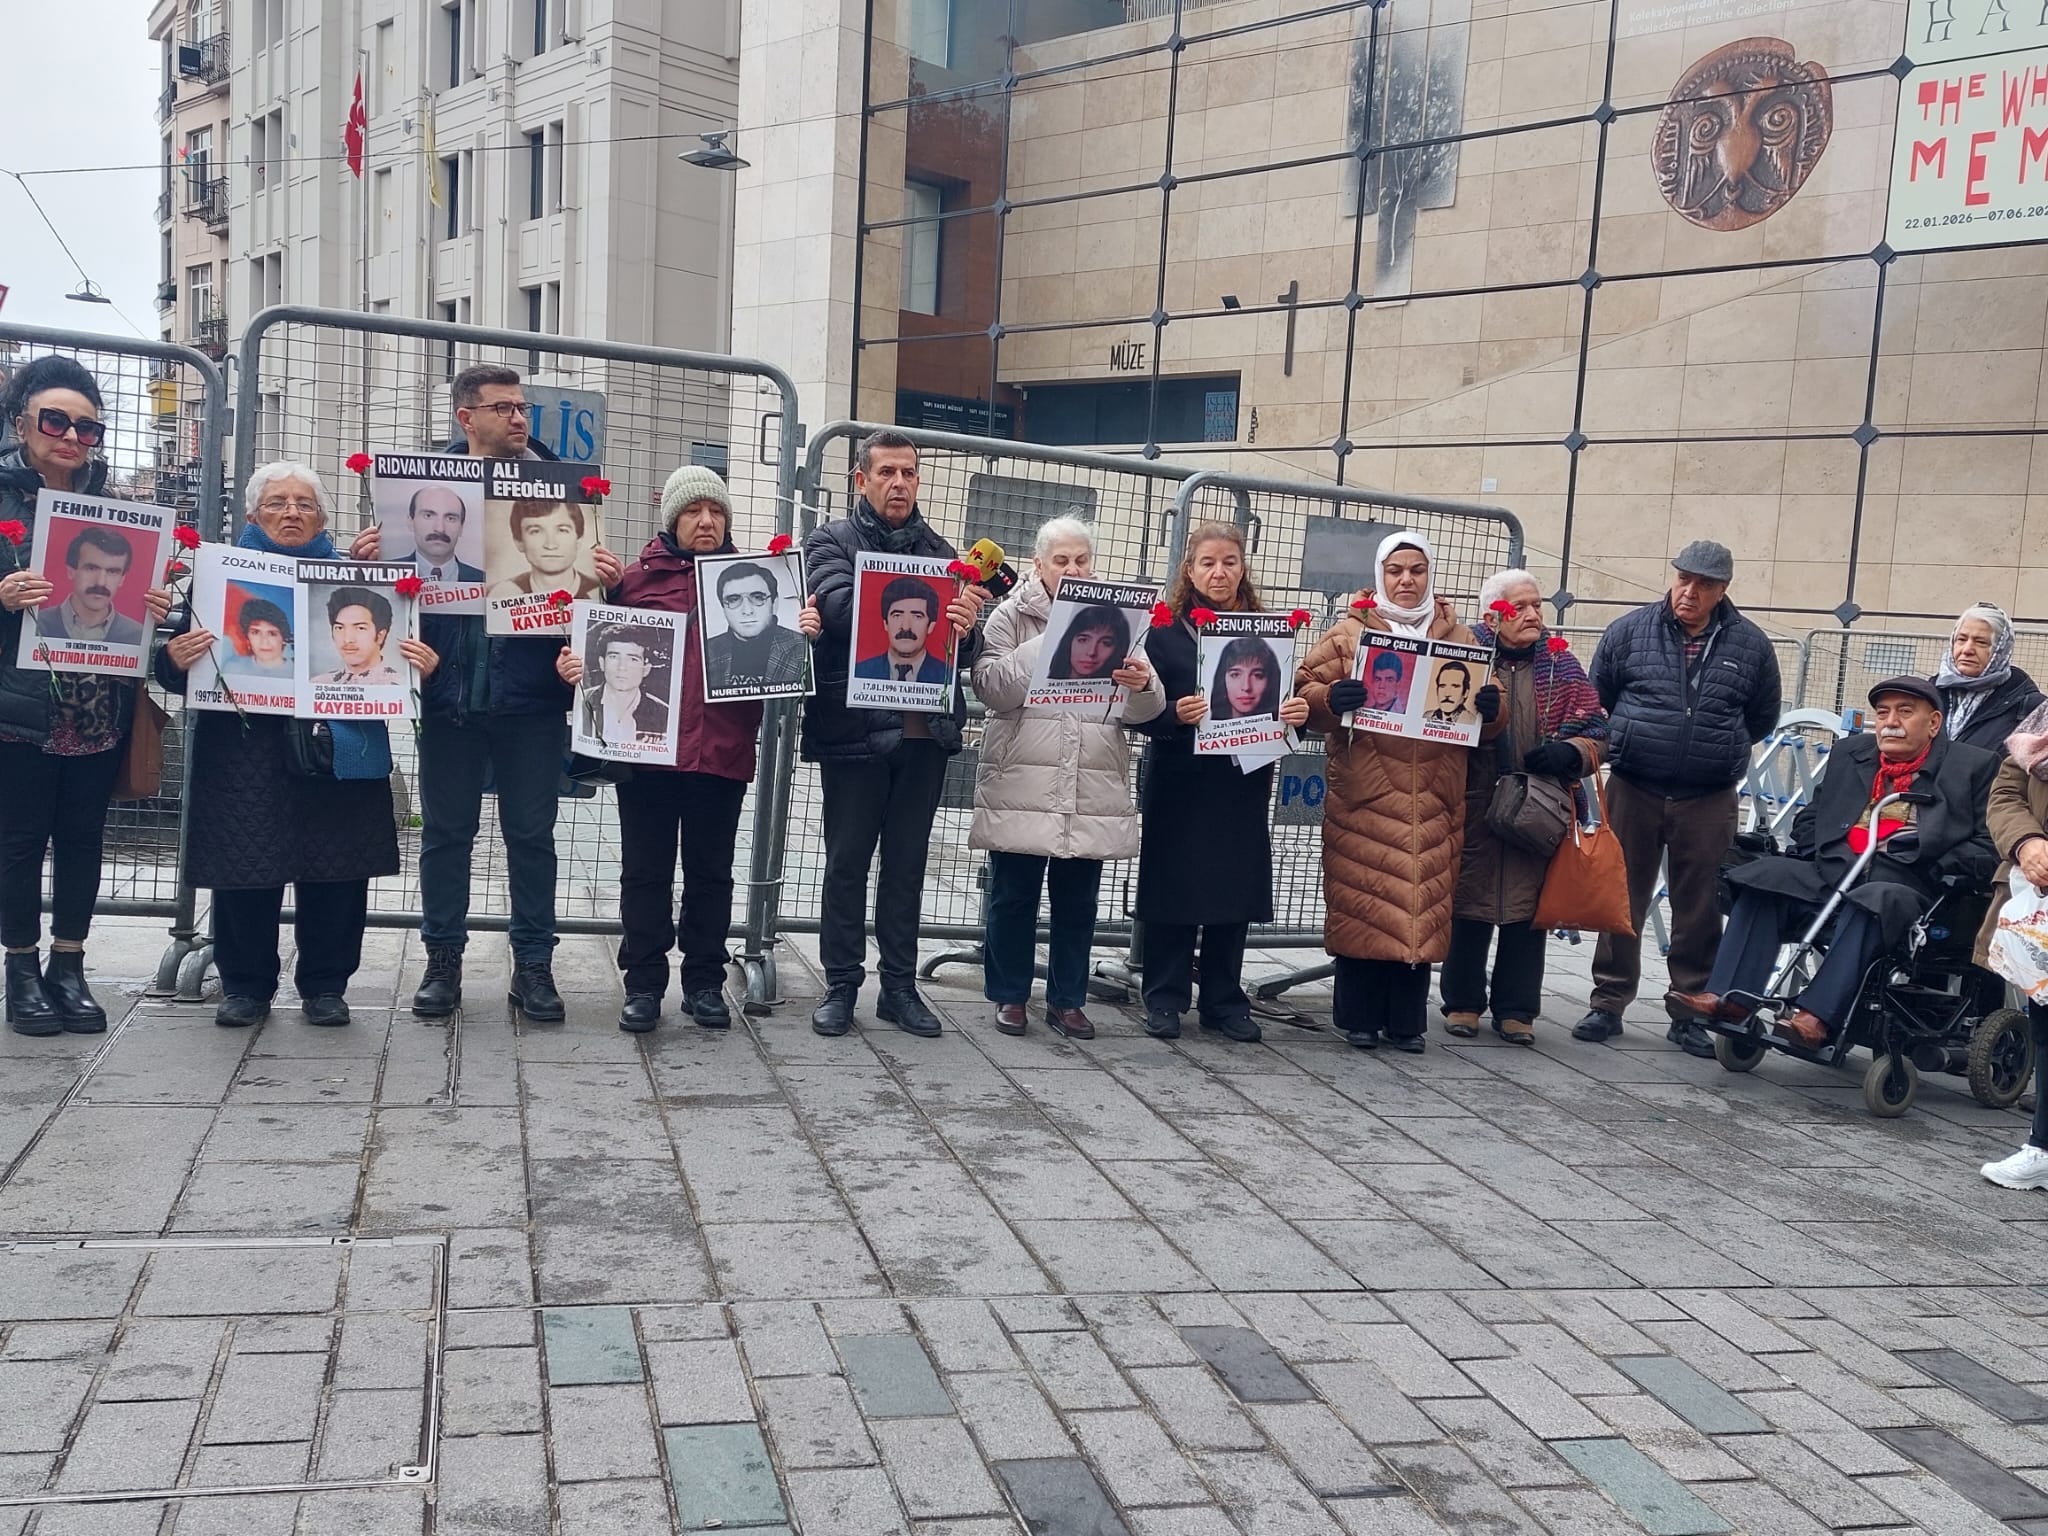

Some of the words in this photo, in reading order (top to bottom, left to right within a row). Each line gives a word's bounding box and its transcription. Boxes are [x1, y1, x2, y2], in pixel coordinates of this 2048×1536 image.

[1687, 13, 1712, 25] from
[1715, 9, 1733, 21] the
[1917, 72, 1988, 127] THE
[1110, 340, 1146, 371] MÜZE
[377, 457, 426, 476] RIDVAN
[492, 479, 566, 499] EFEOĞLU
[52, 500, 103, 518] FEHMİ
[107, 508, 163, 528] TOSUN
[222, 556, 266, 571] ZOZAN
[271, 563, 294, 576] ERE
[299, 565, 358, 581] MURAT
[359, 566, 414, 582] YILDIZ
[862, 559, 919, 574] ABDULLAH
[922, 564, 953, 576] CANA
[1060, 583, 1113, 601] AYŞENUR
[1114, 589, 1155, 605] ŞİMŞEK
[491, 601, 498, 610] 5
[500, 596, 526, 609] OCAK
[510, 602, 560, 617] GÖZALTIND
[512, 609, 574, 631] KAYBED
[589, 608, 628, 622] BEDRİ
[630, 612, 674, 628] ALGAN
[1370, 635, 1392, 648] EDİP
[1392, 638, 1419, 652] ÇELİK
[87, 653, 138, 669] KAYBEDİLDİ
[1434, 644, 1468, 658] İBRAHİM
[1468, 649, 1489, 663] ÇELİK
[195, 689, 222, 704] 1997'DE
[314, 691, 365, 701] GÖZALTINDA
[712, 685, 760, 697] NURETTİN
[763, 682, 803, 694] YEDİGÖL
[862, 682, 897, 693] 17.01.1996
[899, 685, 940, 696] TARİHİNDE
[1030, 687, 1093, 696] GÖZALTINDA
[853, 691, 900, 704] GÖZALTINDA
[1029, 692, 1124, 706] KAYBEDİLDİ
[313, 699, 403, 715] KAYBEDİLDİ
[1354, 716, 1403, 733] KAYBEDİLDİ
[1198, 726, 1257, 741] GÖZALTINDA
[1199, 730, 1284, 751] KAYBEDİLD
[1422, 728, 1470, 742] KAYBEDİLDİ
[598, 749, 642, 760] KAYBEDİLDİ
[637, 744, 669, 753] ALTINDA
[1281, 774, 1325, 807] PO
